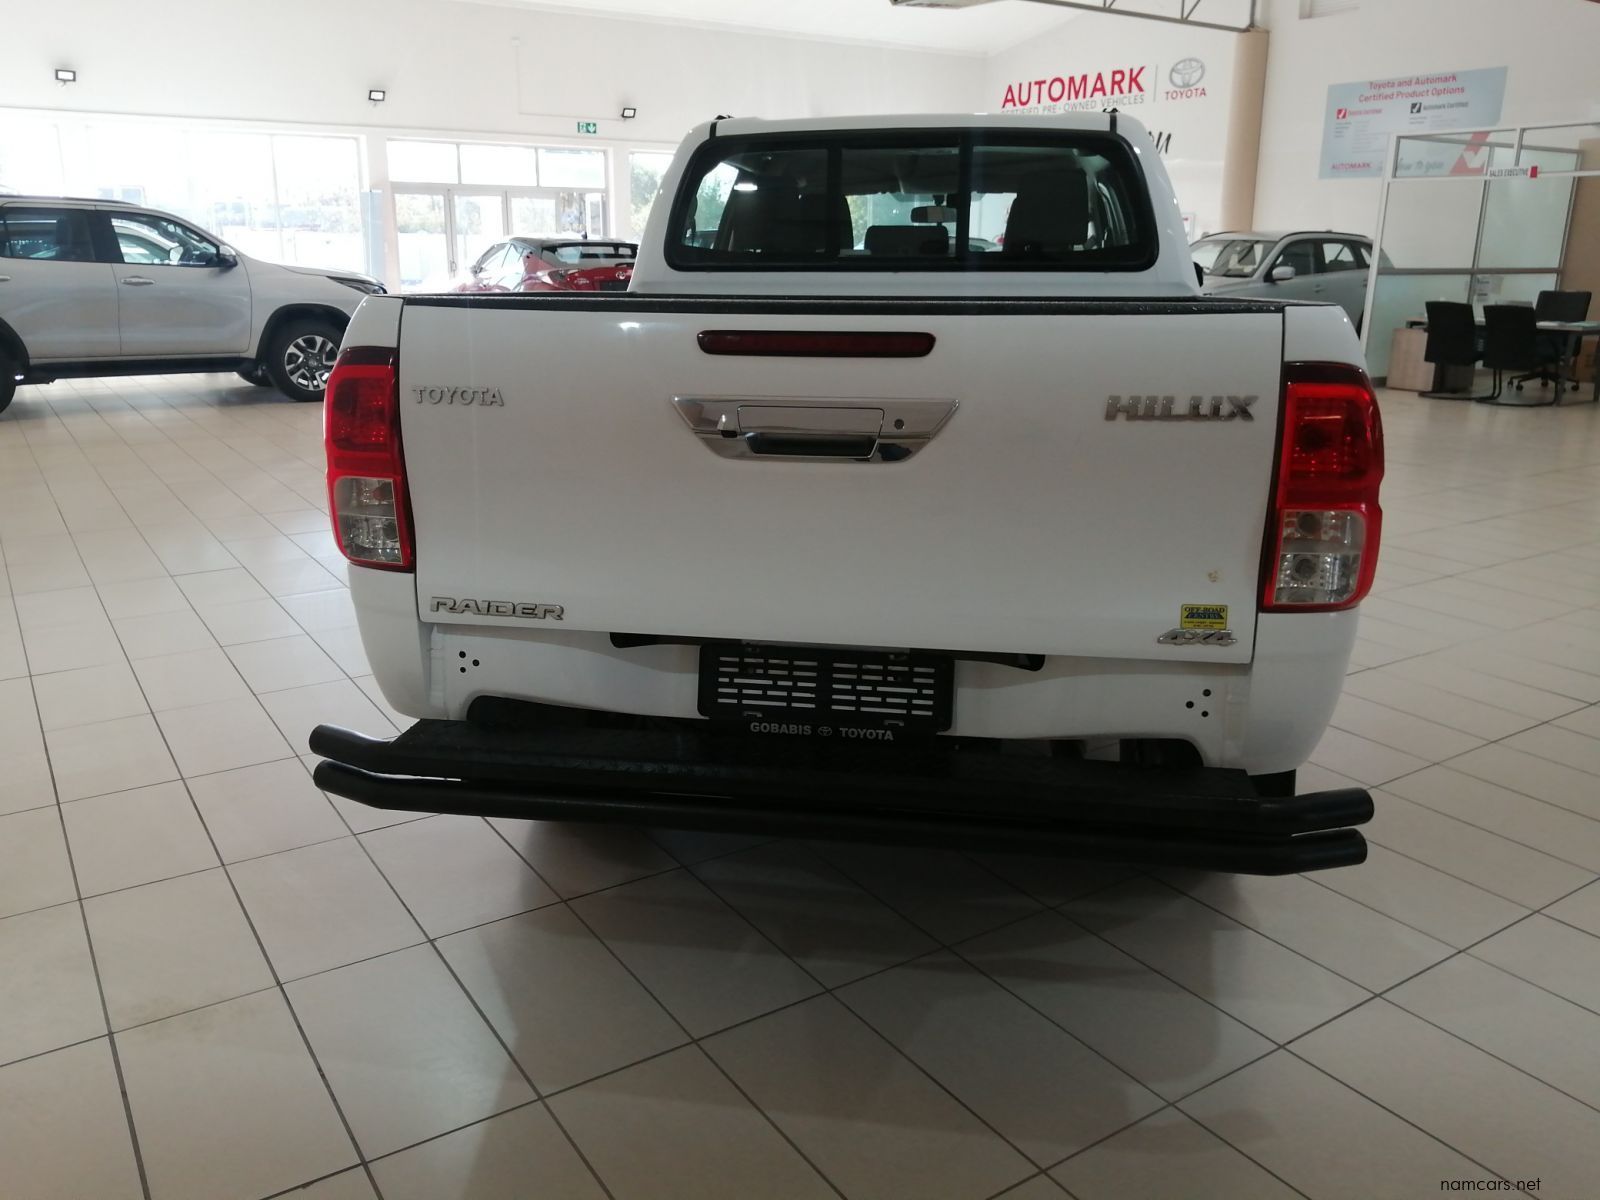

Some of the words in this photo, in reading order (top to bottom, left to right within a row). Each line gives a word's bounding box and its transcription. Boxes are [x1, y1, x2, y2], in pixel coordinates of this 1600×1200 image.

[1002, 66, 1146, 108] AUTOMARK
[1369, 80, 1395, 91] Toyota
[1397, 79, 1412, 87] and
[1414, 74, 1457, 86] Automark
[1101, 94, 1144, 107] VEHICLES
[1165, 87, 1207, 100] TOYOTA
[1359, 92, 1394, 103] Certified
[1395, 88, 1429, 99] Product
[1431, 86, 1465, 97] Options
[412, 384, 504, 407] TOYOTA
[1104, 395, 1259, 421] HILUX
[430, 596, 564, 620] RAIDER
[750, 722, 812, 736] GOBABIS
[839, 727, 894, 741] TOYOTA
